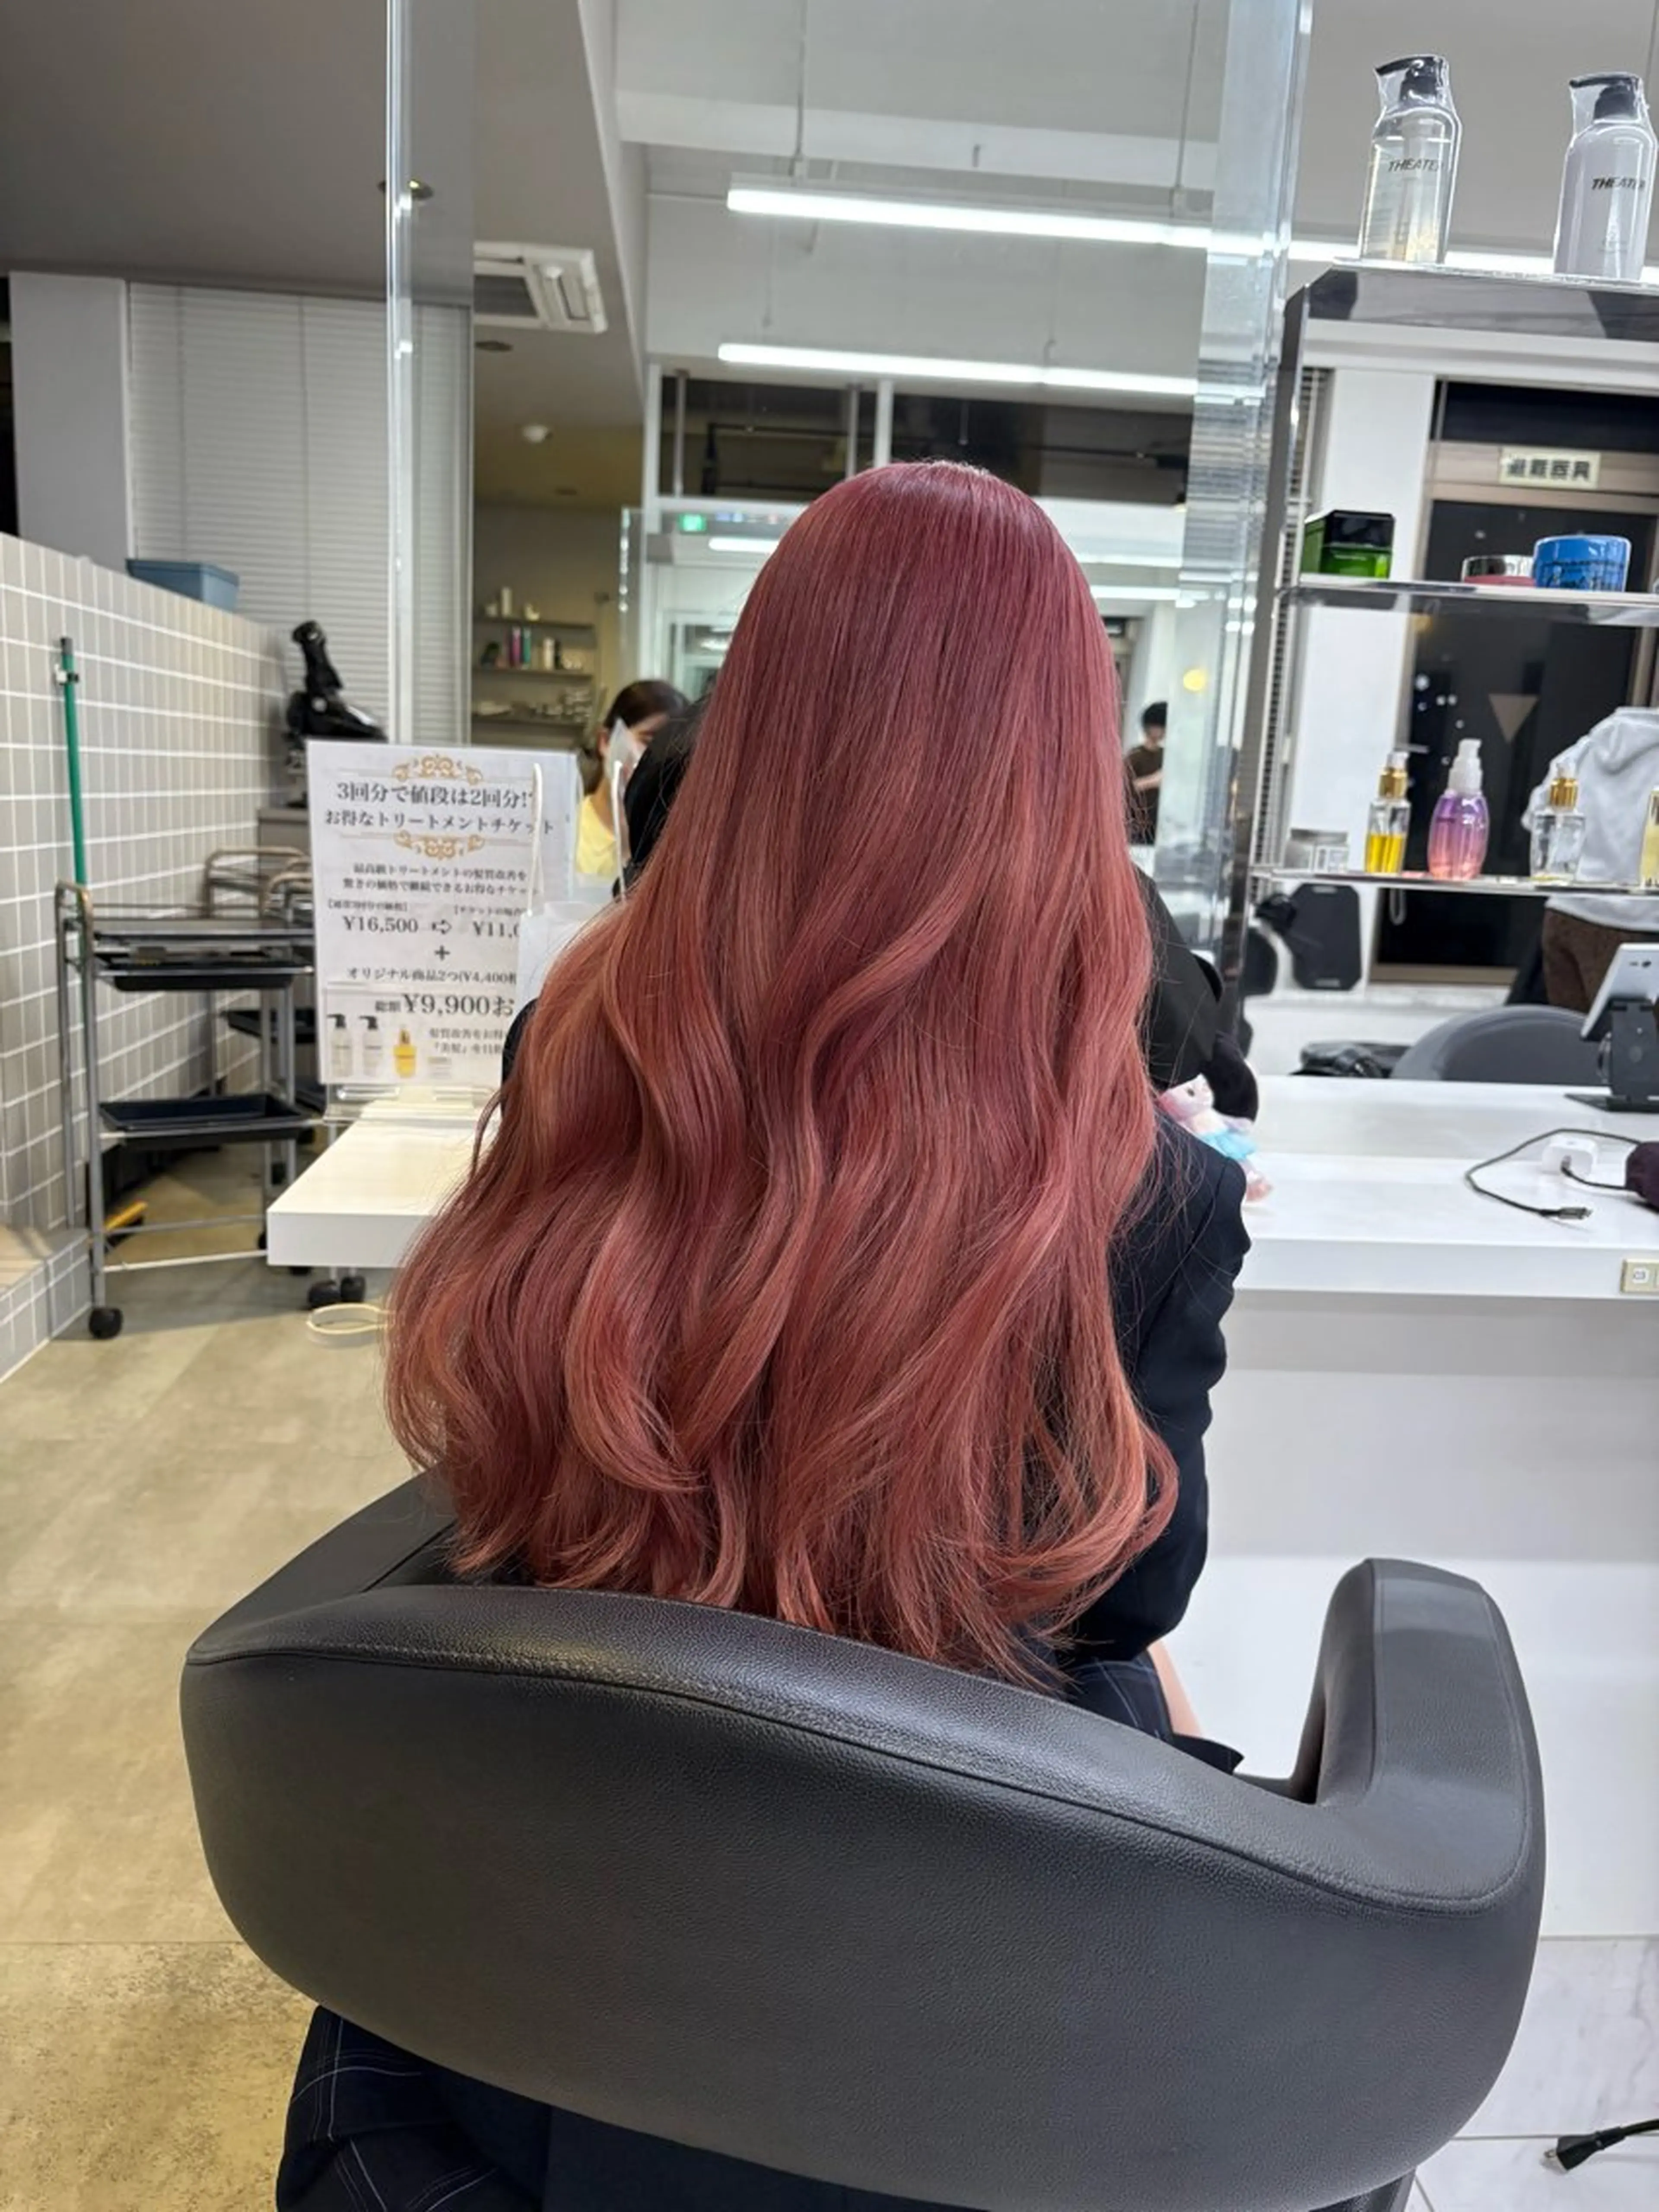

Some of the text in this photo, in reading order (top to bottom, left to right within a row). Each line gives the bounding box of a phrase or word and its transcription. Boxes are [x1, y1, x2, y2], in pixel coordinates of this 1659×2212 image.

[337, 781, 533, 809] 3回分で値段は2回分!
